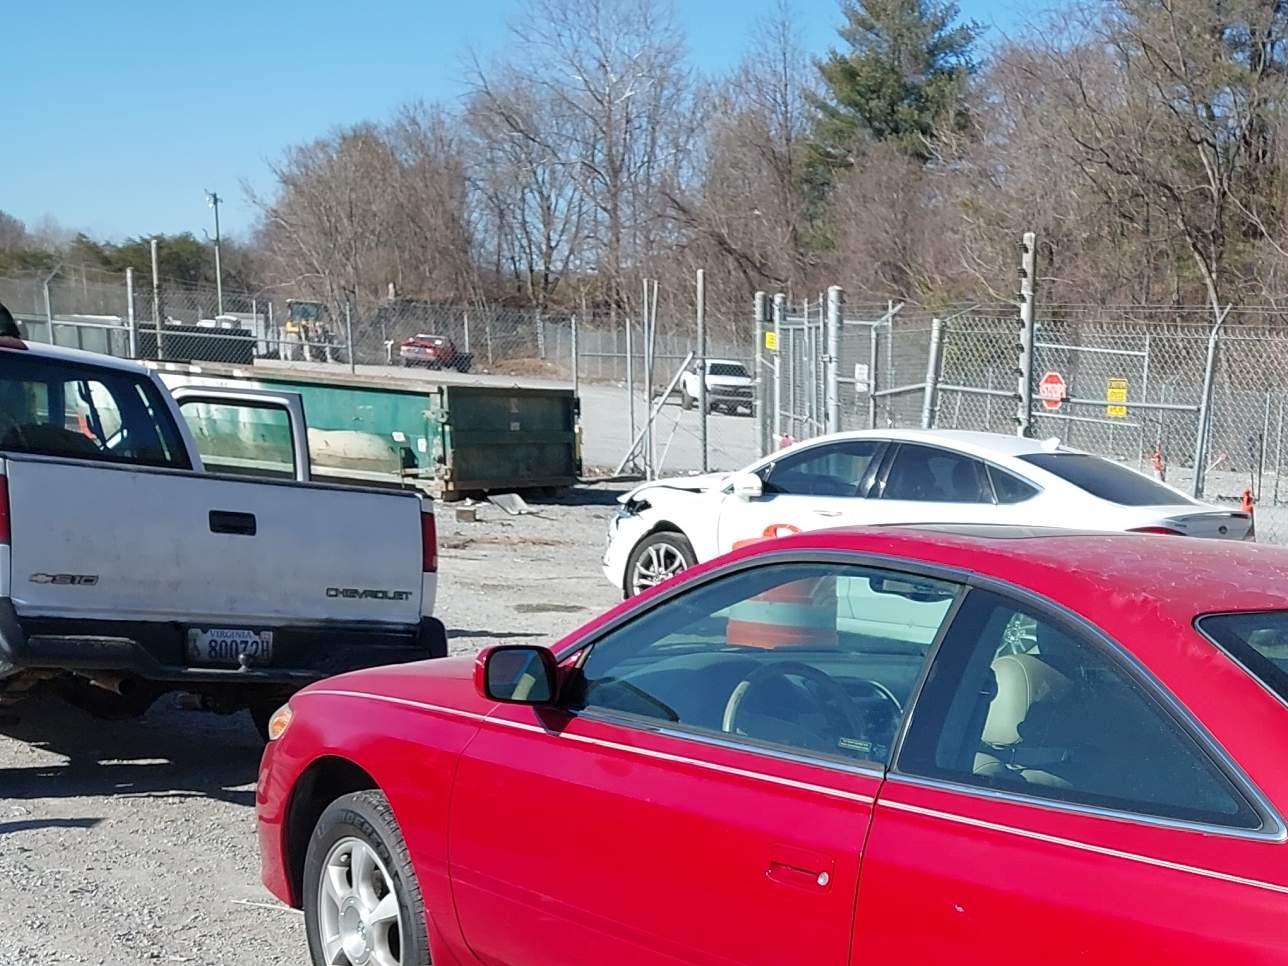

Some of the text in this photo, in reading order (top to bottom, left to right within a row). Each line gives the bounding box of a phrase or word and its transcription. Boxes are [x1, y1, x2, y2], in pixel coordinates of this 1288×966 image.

[1040, 384, 1066, 399] STOP
[326, 587, 413, 601] CHEVROLET
[210, 630, 253, 640] VIRGINIA
